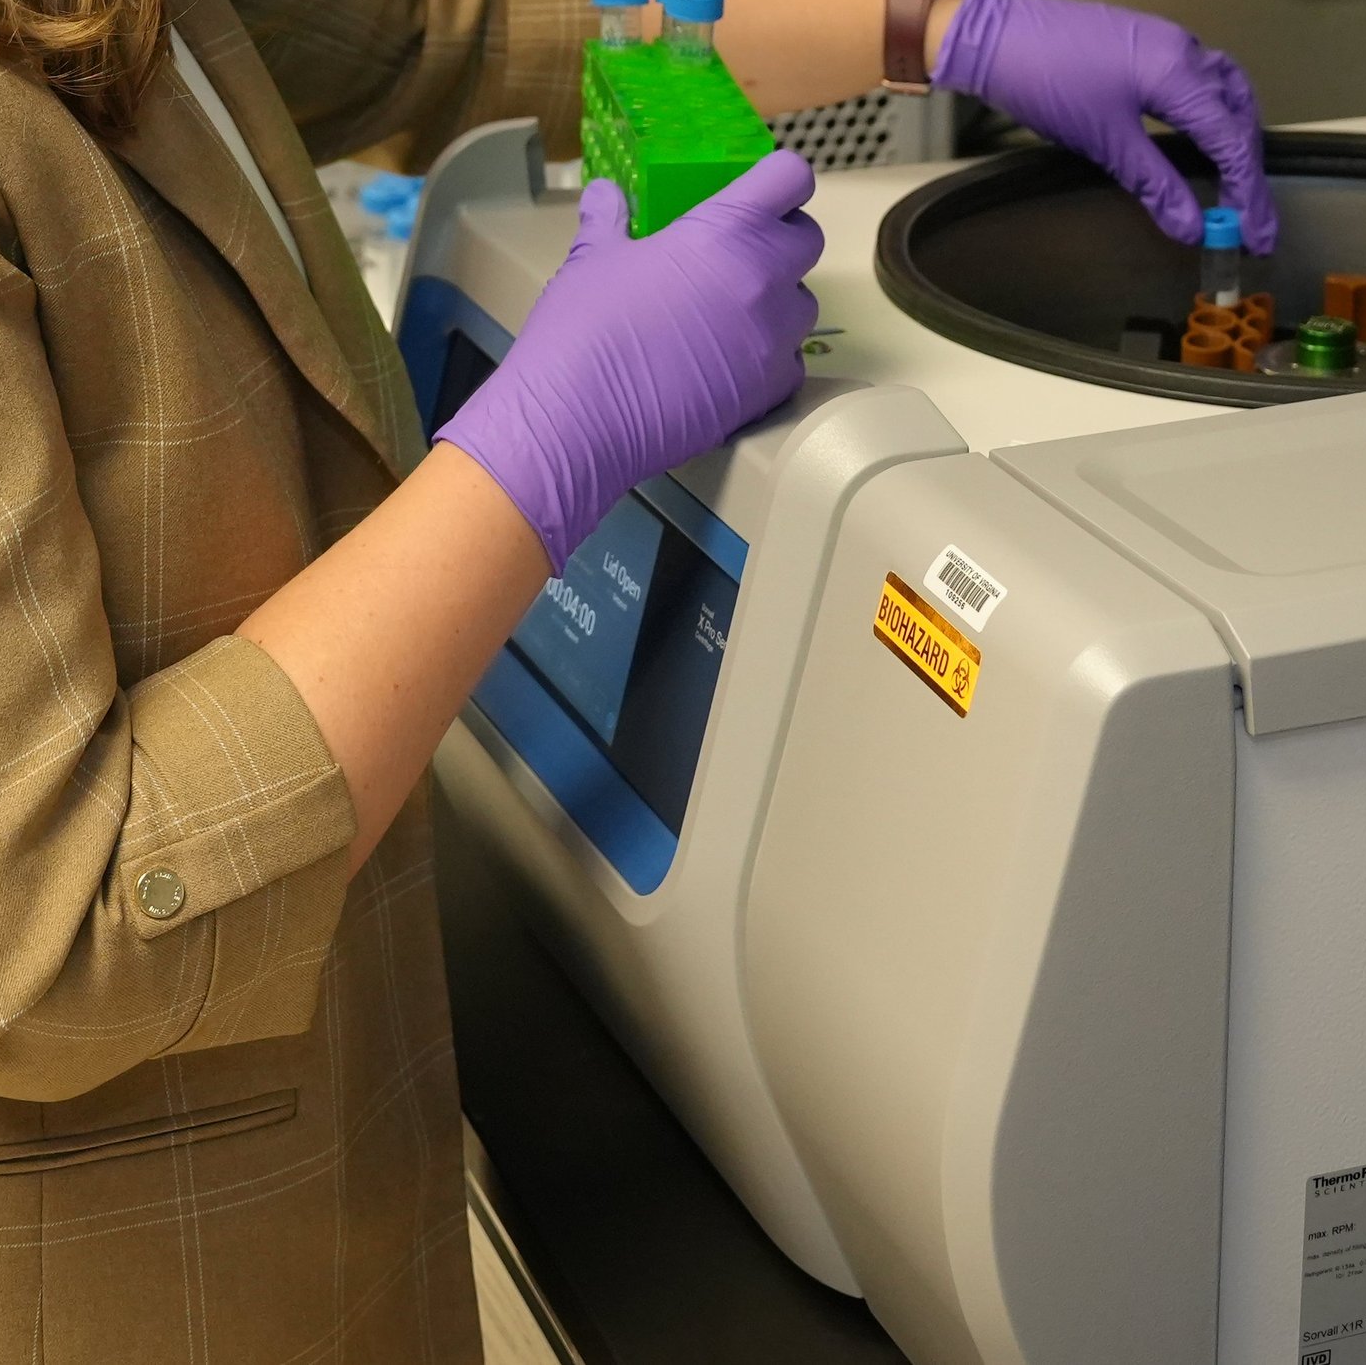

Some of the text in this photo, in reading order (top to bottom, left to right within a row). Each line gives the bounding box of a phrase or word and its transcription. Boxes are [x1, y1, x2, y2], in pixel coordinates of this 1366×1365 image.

[603, 551, 619, 580] Lid
[617, 566, 641, 602] Open
[945, 550, 1001, 599] UNIVERSITY OF VIRGINIA
[945, 589, 966, 610] 109256
[703, 620, 716, 640] Pro
[878, 593, 950, 678] BIOHAZARD
[1303, 1326, 1339, 1342] Sorvall
[1341, 1319, 1363, 1334] X1R
[1306, 1354, 1327, 1365] IVD
